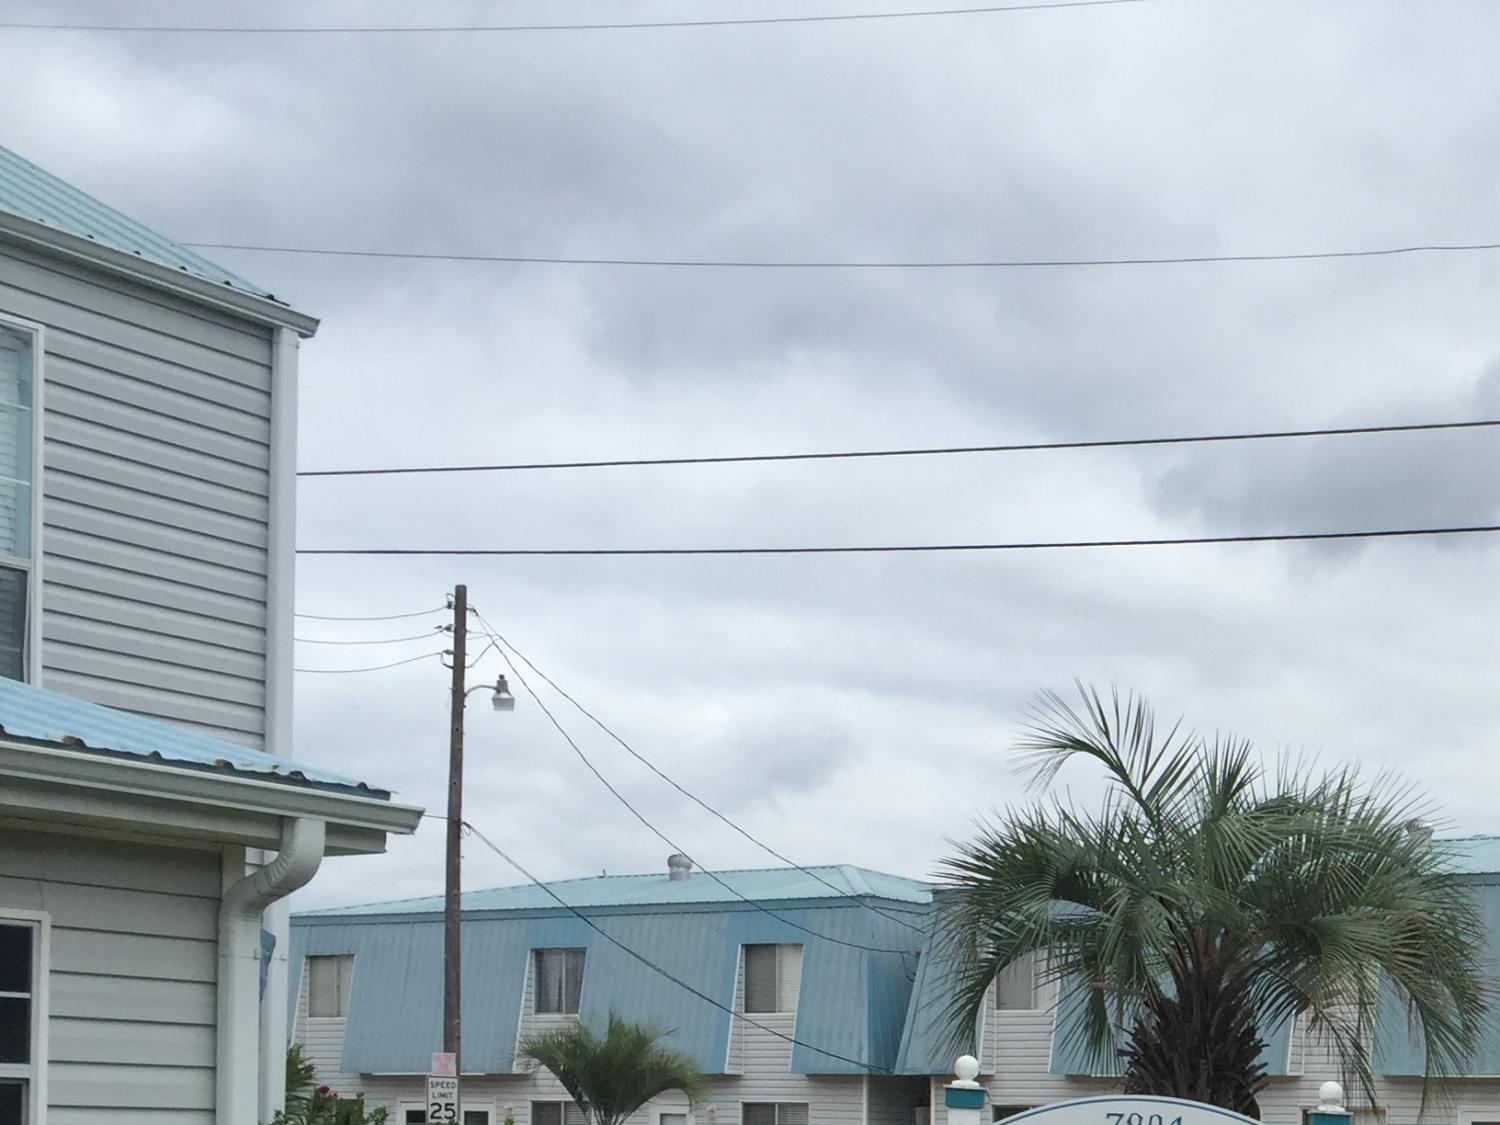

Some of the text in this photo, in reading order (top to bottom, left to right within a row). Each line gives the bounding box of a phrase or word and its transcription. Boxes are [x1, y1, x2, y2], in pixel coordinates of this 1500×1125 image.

[430, 1081, 457, 1089] SPEED
[432, 1091, 453, 1099] LIMIT
[430, 1102, 456, 1120] 25
